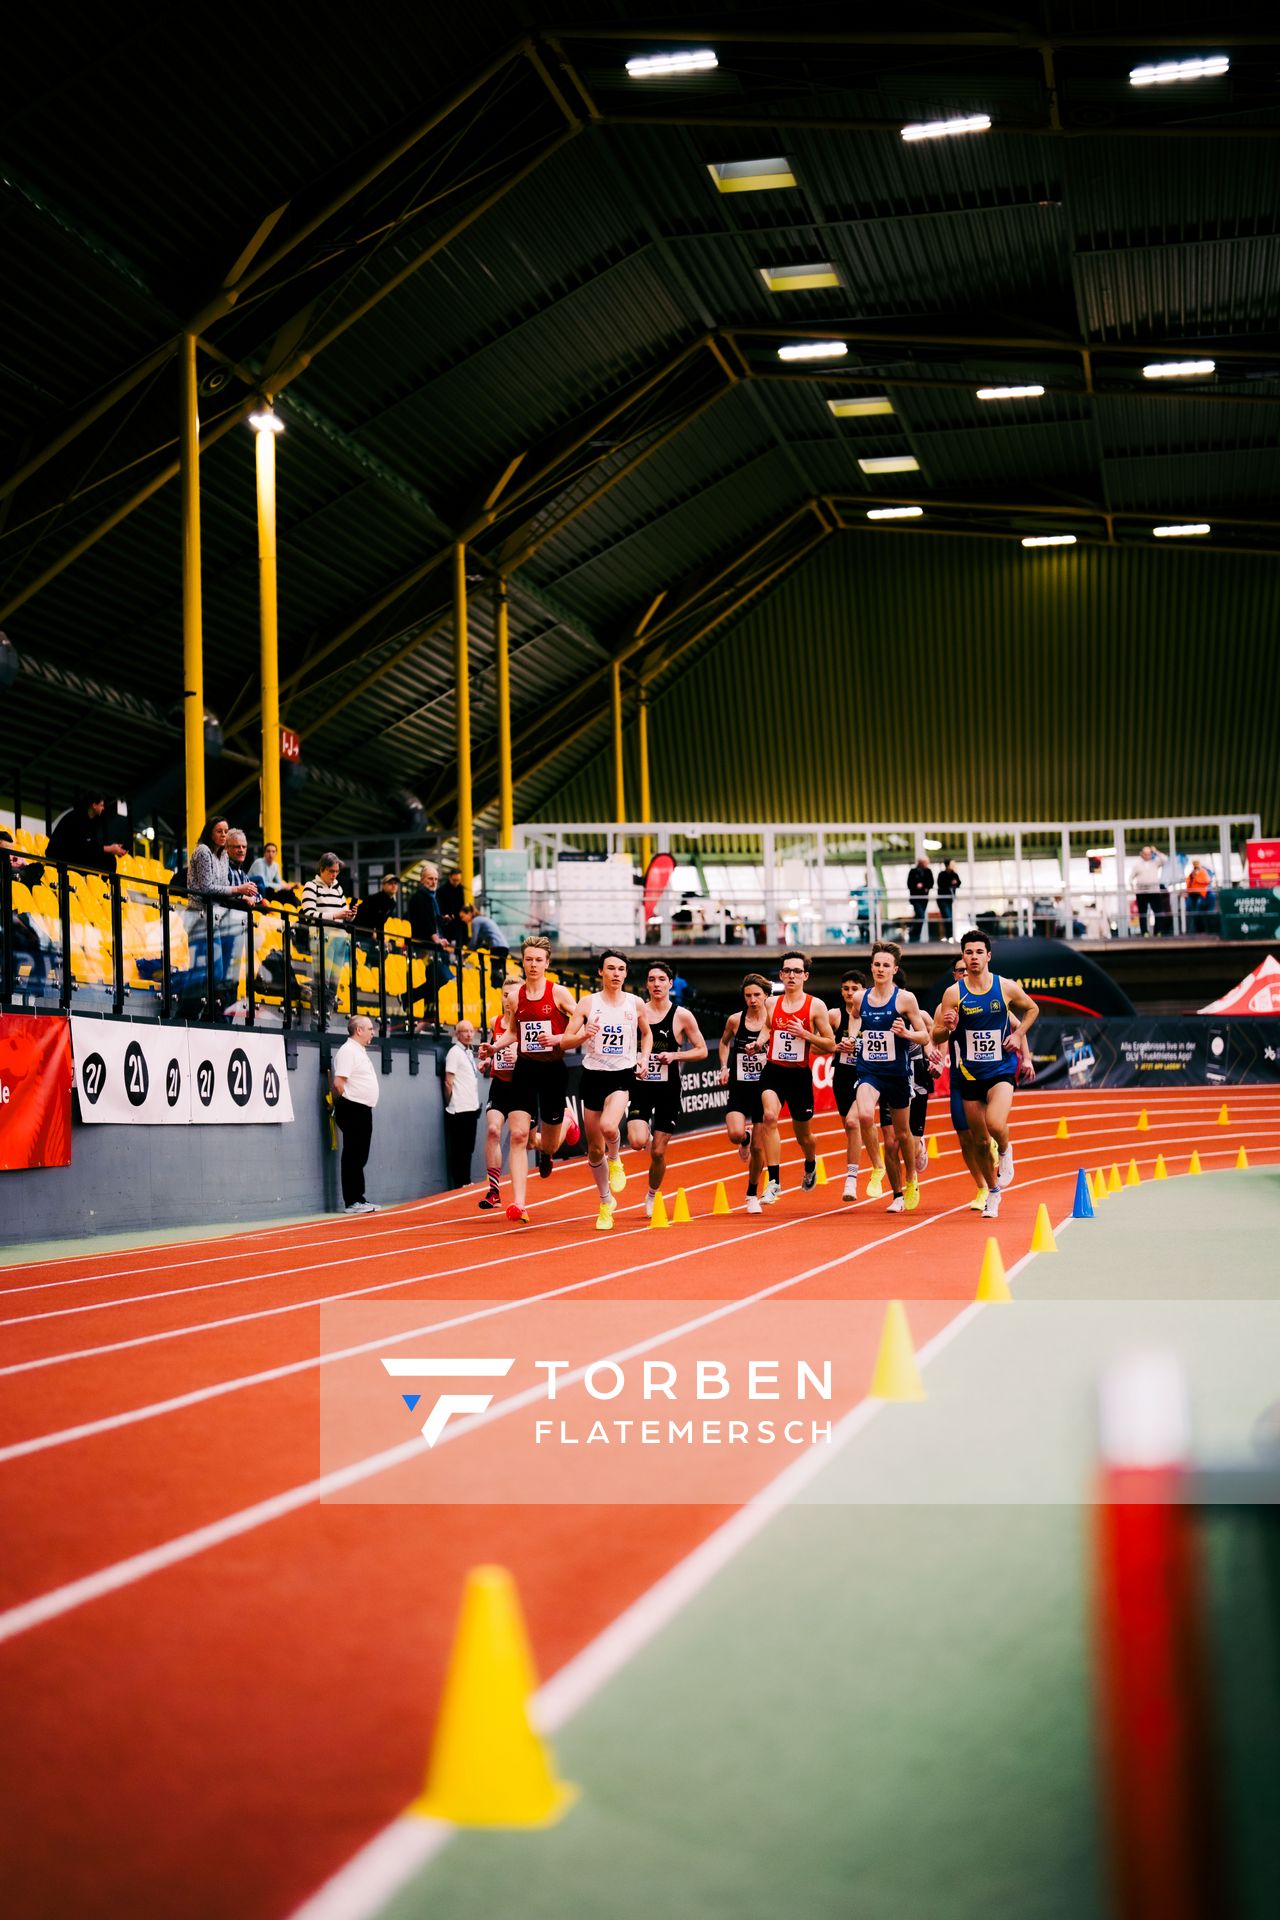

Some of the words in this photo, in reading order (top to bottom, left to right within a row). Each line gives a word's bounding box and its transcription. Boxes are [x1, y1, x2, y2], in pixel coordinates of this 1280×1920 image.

[525, 1031, 545, 1042] 42
[603, 1025, 622, 1033] GLS
[780, 1032, 796, 1040] GLS
[602, 1033, 624, 1046] 721
[784, 1041, 792, 1052] 5
[867, 1040, 887, 1051] 291
[972, 1040, 996, 1052] 152
[128, 1054, 145, 1093] 21
[742, 1063, 762, 1072] 550
[86, 1063, 102, 1094] 21
[169, 1068, 179, 1097] 21
[200, 1069, 212, 1098] 21
[233, 1060, 247, 1095] 21
[680, 1072, 700, 1091] GEN
[701, 1067, 730, 1088] SCH
[264, 1075, 277, 1099] 21
[681, 1090, 730, 1113] VERSPANN
